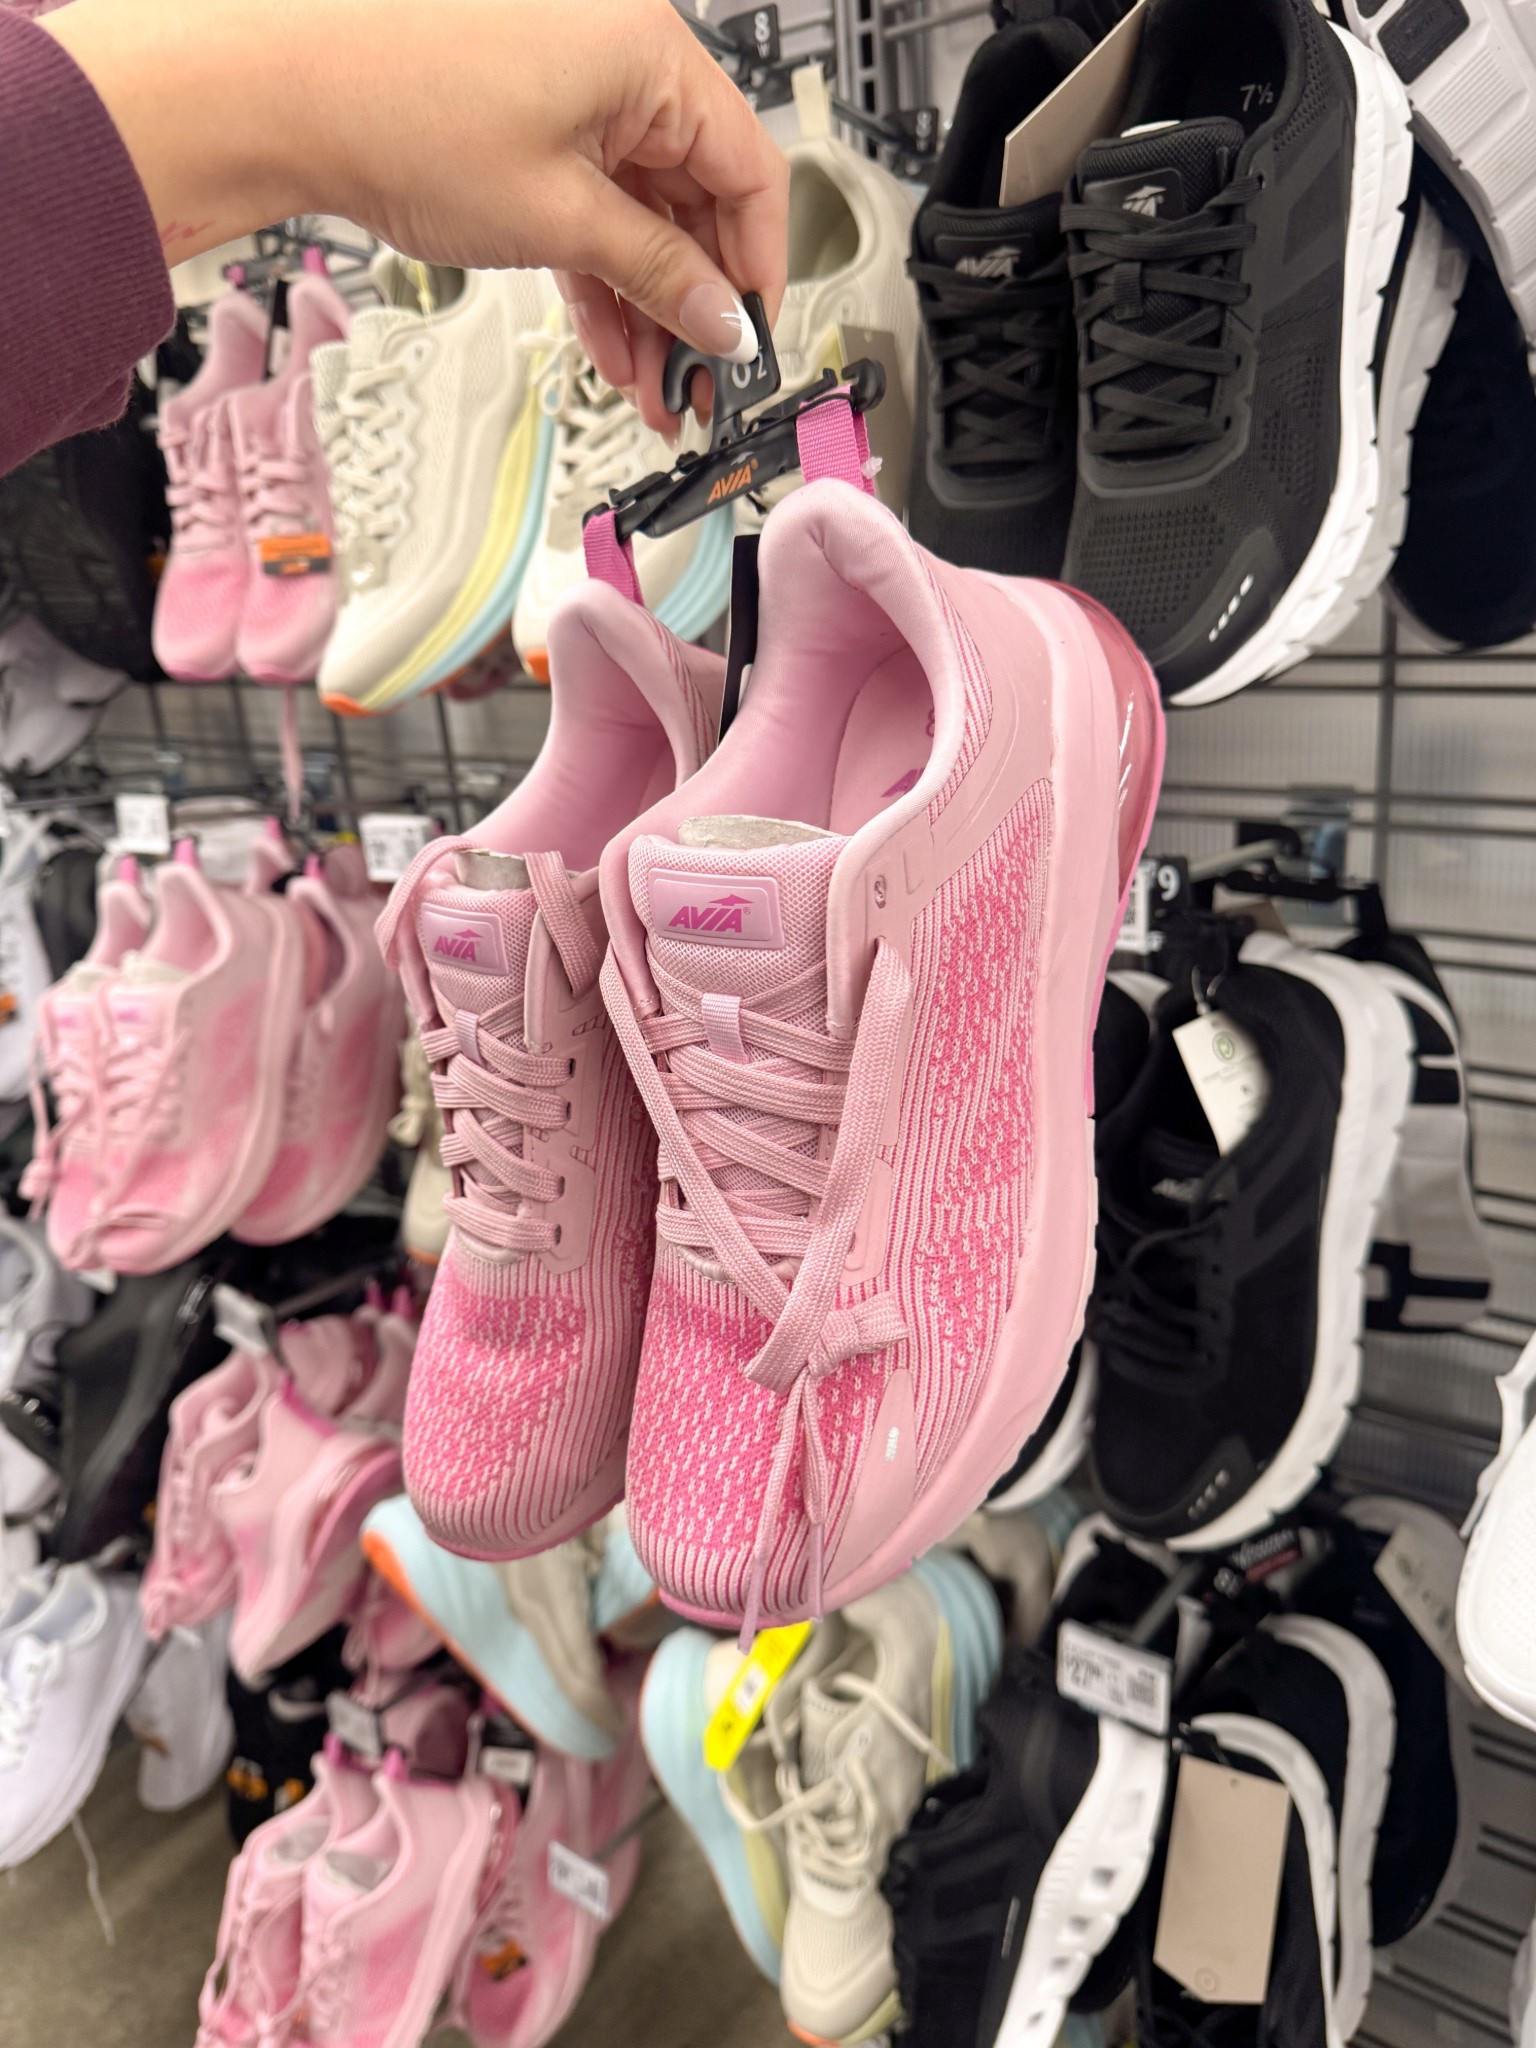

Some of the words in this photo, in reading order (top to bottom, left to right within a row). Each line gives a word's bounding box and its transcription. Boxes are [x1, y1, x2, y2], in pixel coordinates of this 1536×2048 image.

[755, 11, 770, 42] 8
[707, 464, 752, 505] AVIA
[1157, 864, 1180, 902] 9
[668, 906, 743, 934] AVIA
[434, 936, 477, 962] AVIA
